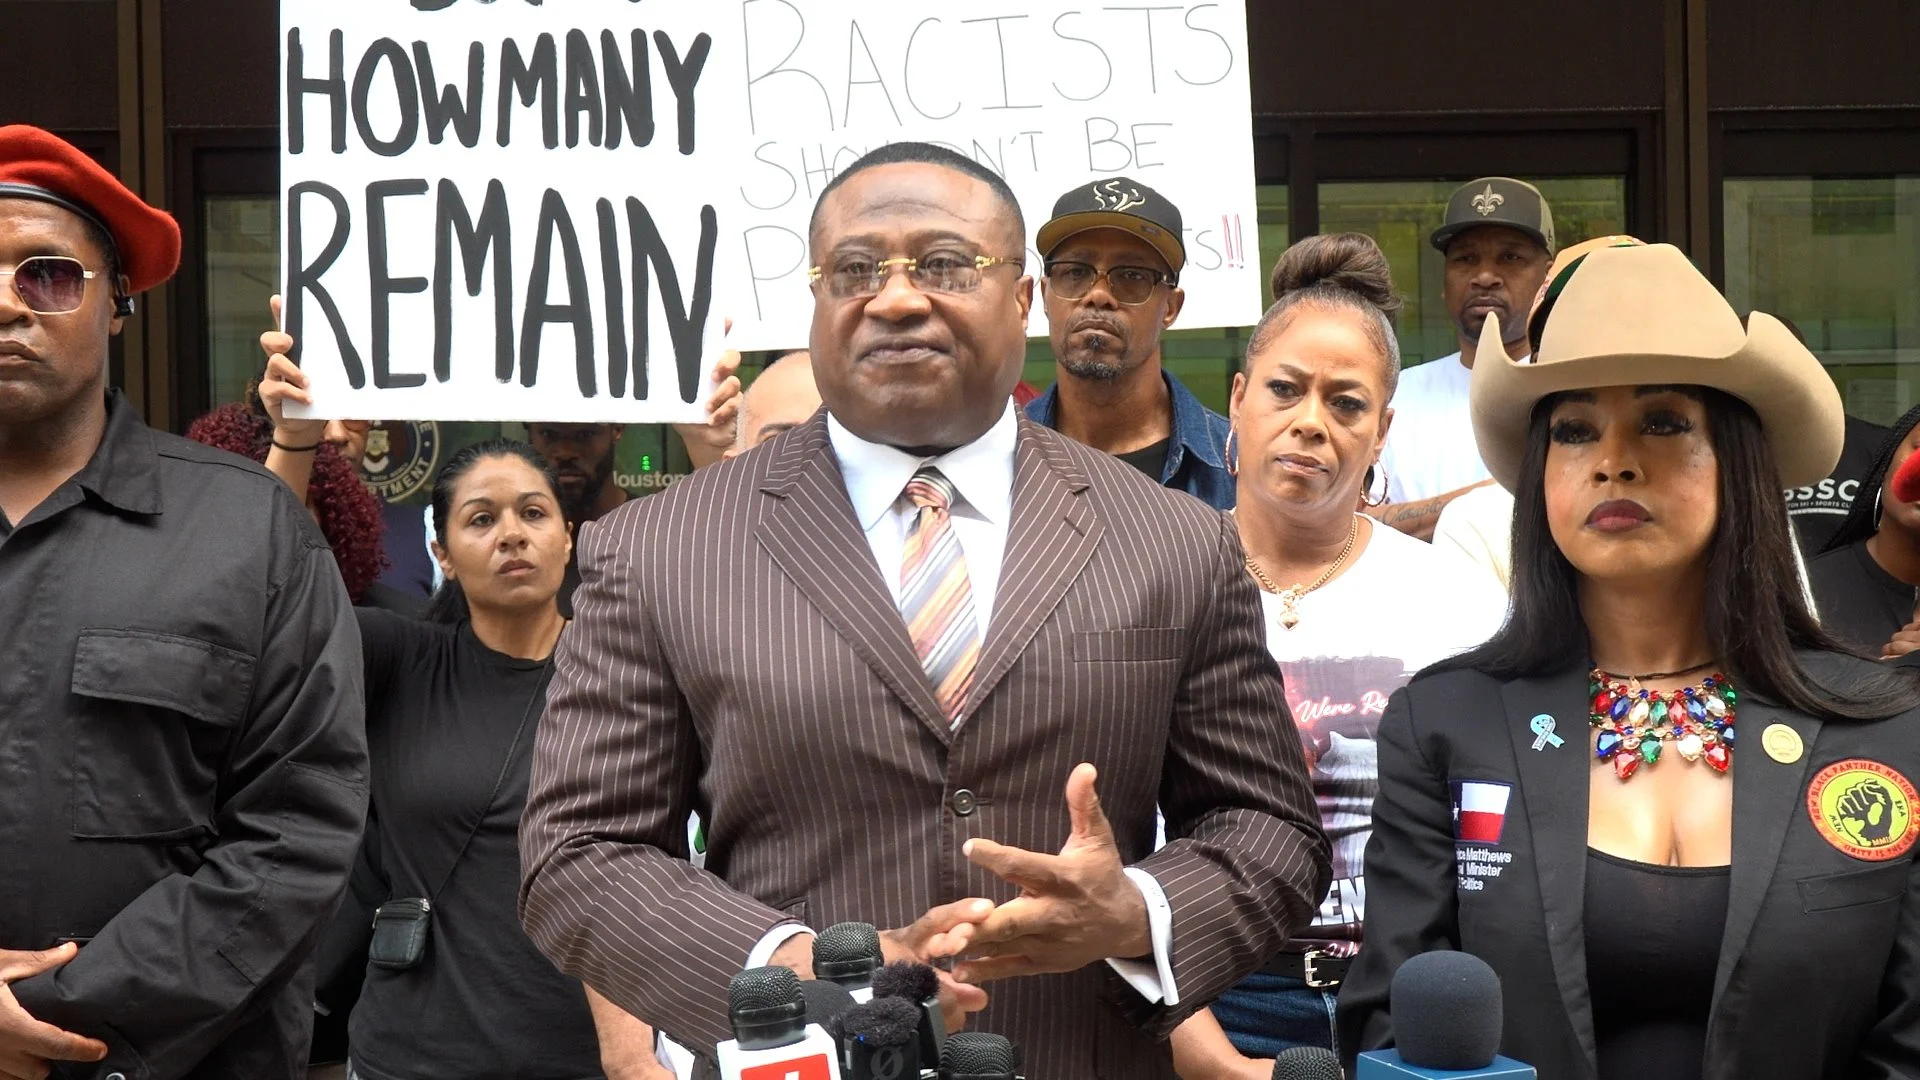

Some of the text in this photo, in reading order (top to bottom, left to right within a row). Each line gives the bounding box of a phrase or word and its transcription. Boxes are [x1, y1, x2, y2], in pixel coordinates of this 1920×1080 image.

[742, 0, 1234, 135] RACISTS
[287, 27, 711, 156] HOW MANY
[740, 117, 1172, 210] SHN'T BE
[286, 178, 718, 404] REMAIN
[367, 456, 430, 497] RTMENT
[1815, 500, 1840, 508] SPORTS
[1295, 690, 1389, 723] Were Re
[1811, 771, 1832, 797] BLACK
[1833, 762, 1881, 774] PANTHER
[1466, 848, 1512, 862] Matthews
[1466, 862, 1502, 876] Minister
[1310, 876, 1365, 926] EN
